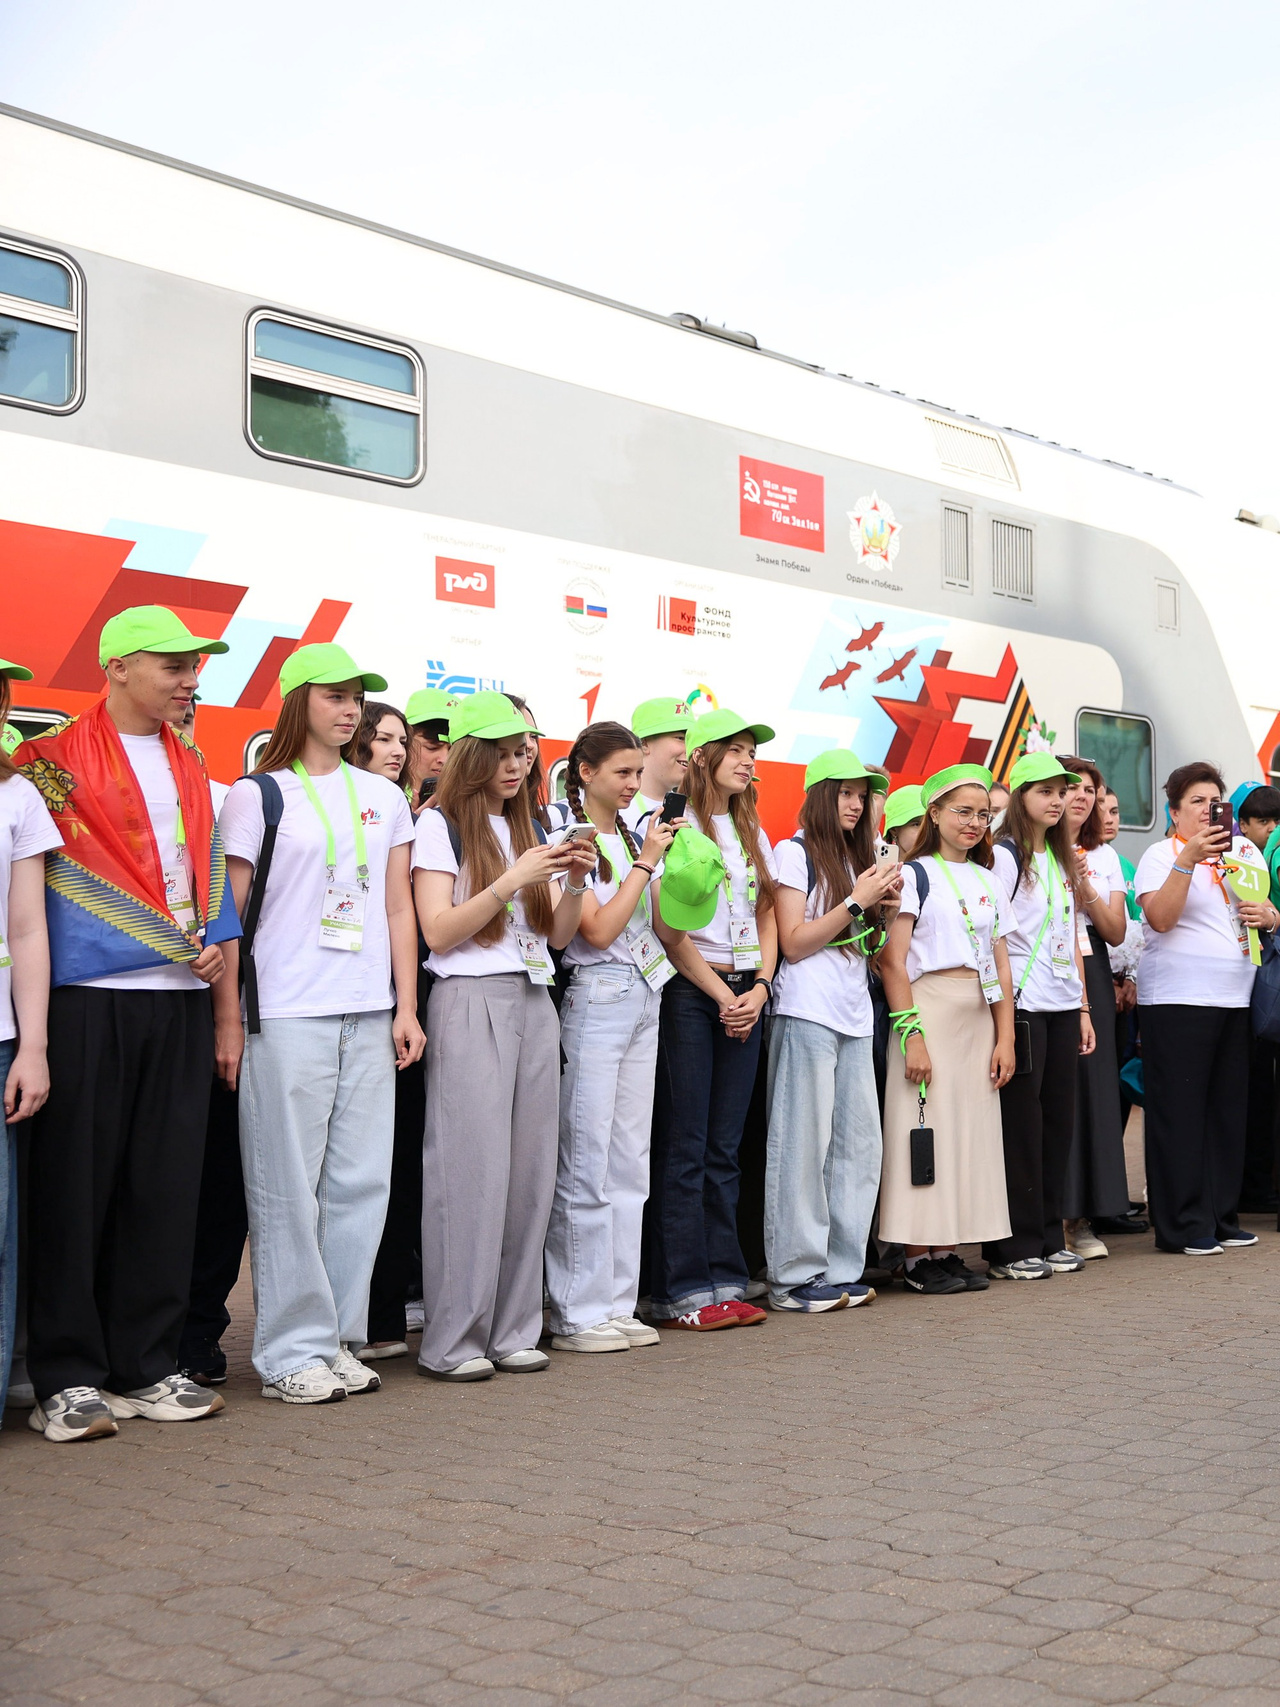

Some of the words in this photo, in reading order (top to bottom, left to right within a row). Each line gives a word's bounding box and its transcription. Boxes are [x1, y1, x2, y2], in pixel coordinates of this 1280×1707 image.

[755, 554, 780, 567] Знамя
[781, 559, 811, 574] Победы
[846, 573, 870, 587] Орден
[680, 611, 731, 628] Культурное
[704, 606, 731, 619] ФОНД
[671, 623, 731, 639] пространство
[1237, 865, 1260, 891] 2.1
